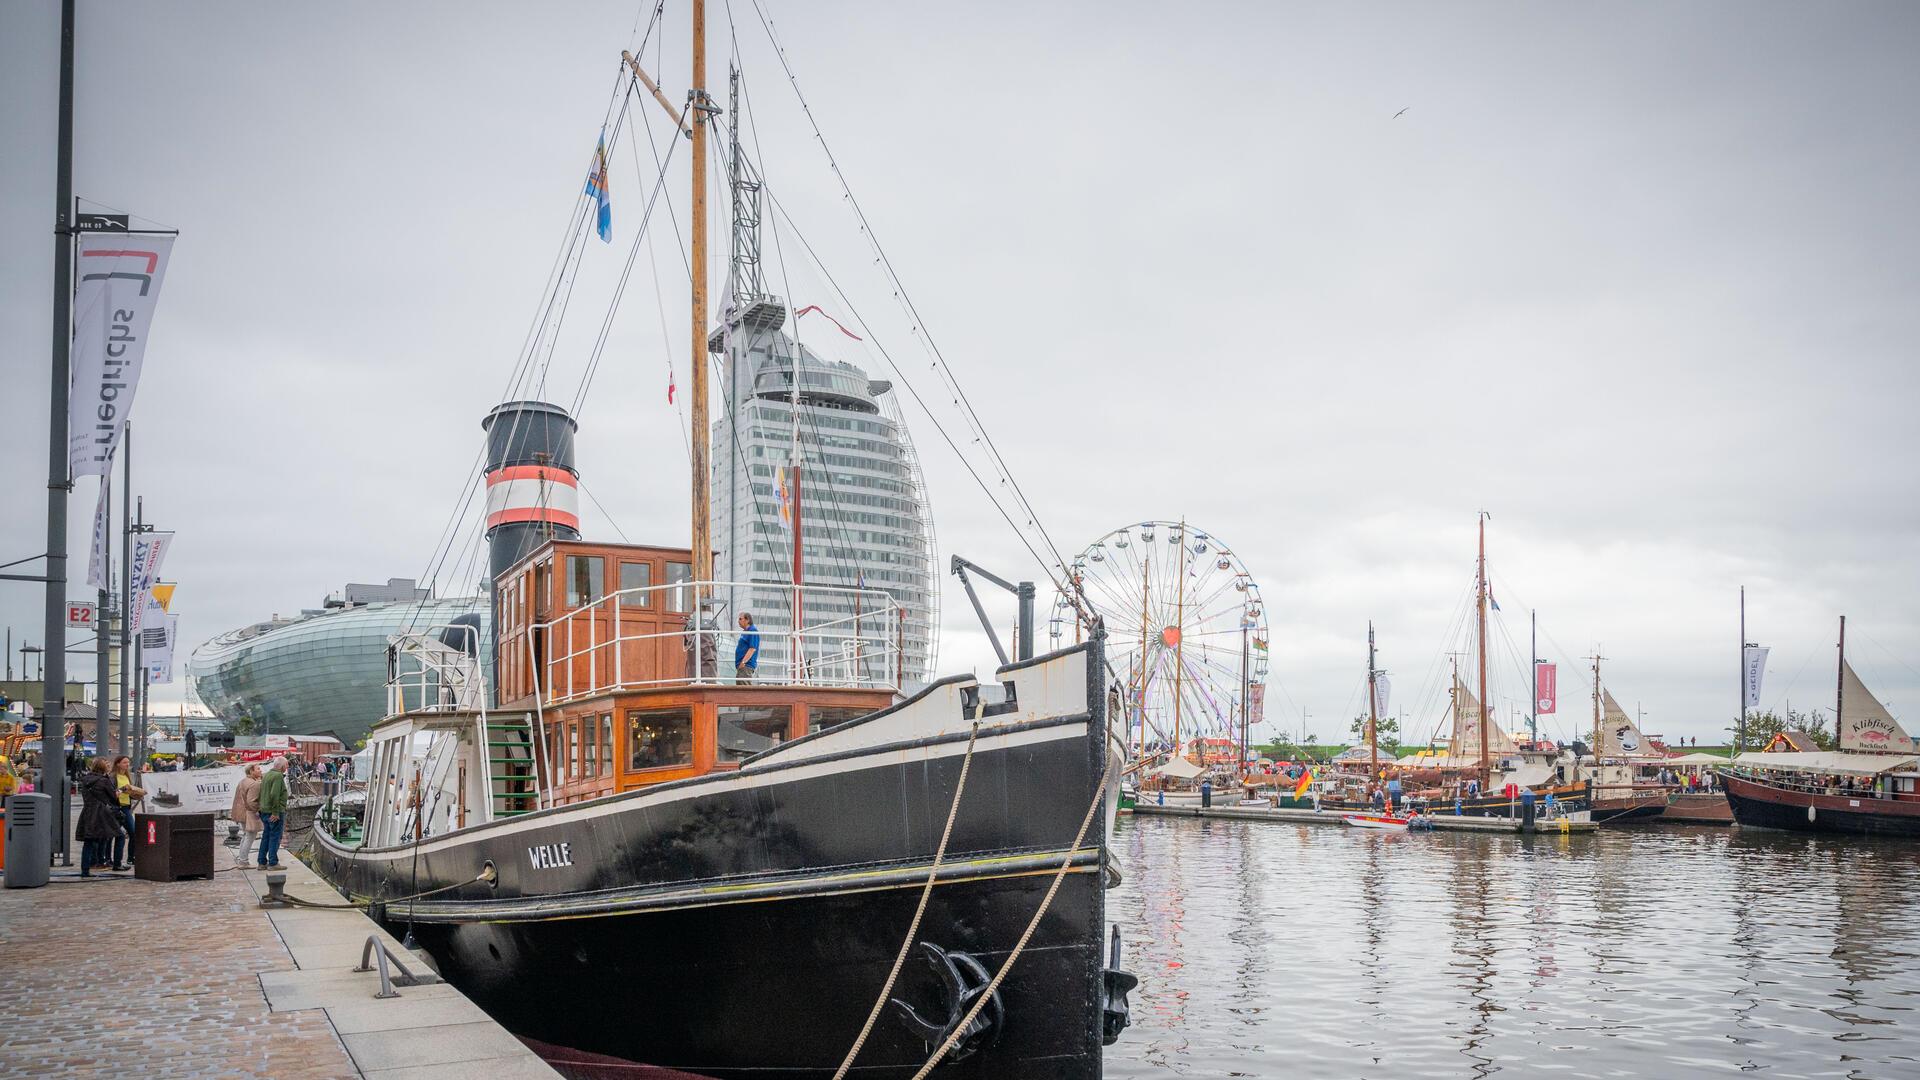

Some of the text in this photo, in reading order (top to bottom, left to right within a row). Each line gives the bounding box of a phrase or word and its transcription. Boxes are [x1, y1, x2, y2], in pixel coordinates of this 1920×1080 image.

[70, 607, 91, 622] E2
[196, 783, 230, 794] WELLE
[528, 842, 573, 870] WELLE
